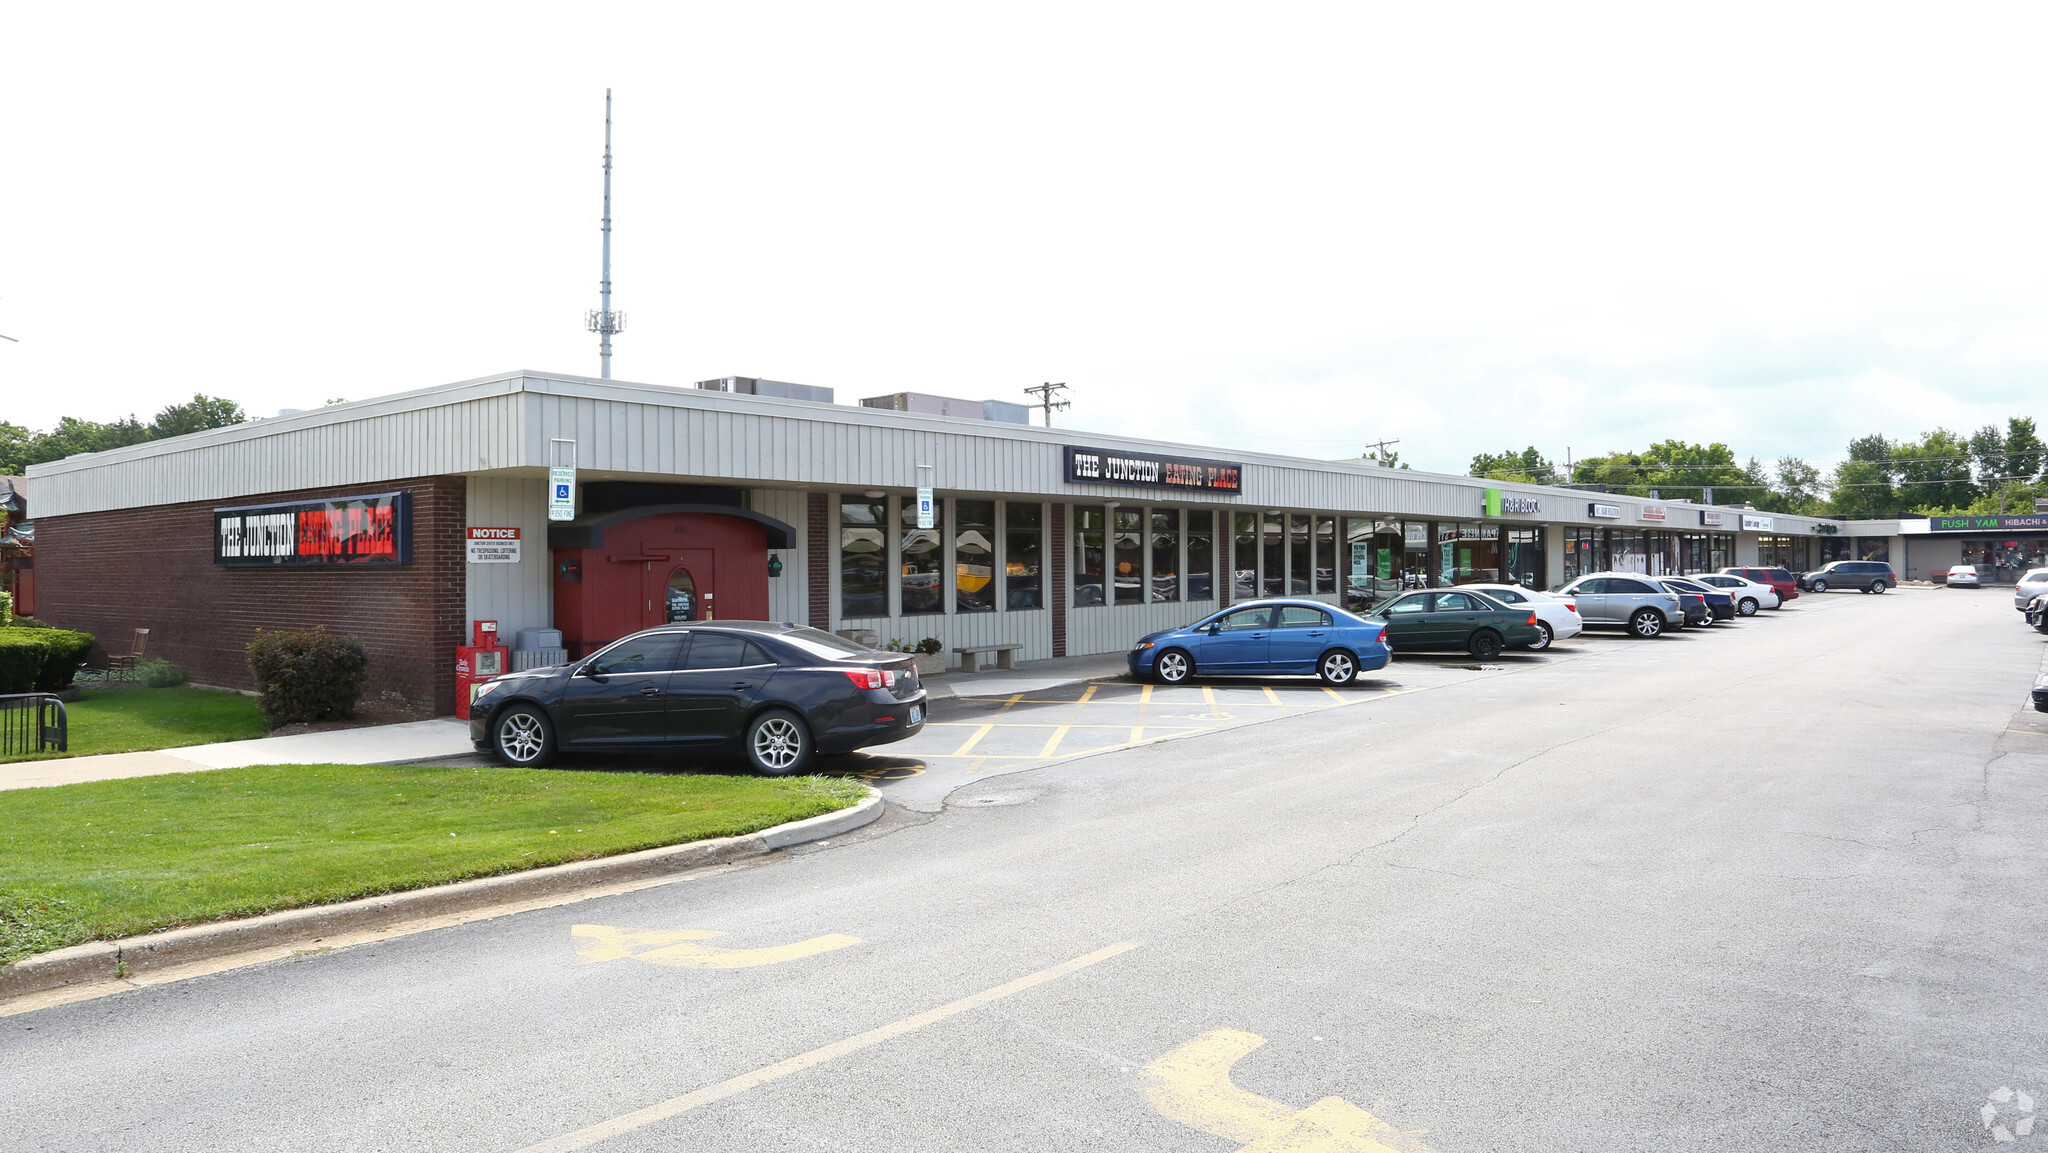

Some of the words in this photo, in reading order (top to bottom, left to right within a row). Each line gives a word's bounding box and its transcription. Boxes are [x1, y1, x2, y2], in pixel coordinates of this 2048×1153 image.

[1075, 454, 1099, 477] THE
[1105, 457, 1159, 482] JUNCTION
[1165, 463, 1203, 486] EATING
[1207, 467, 1238, 488] PLACE
[1503, 498, 1520, 512] H&R
[1521, 498, 1541, 513] BLOCK
[563, 510, 573, 518] FINE
[221, 517, 241, 557] THE
[243, 513, 295, 557] JUNCTION
[298, 509, 342, 555] EATING
[348, 506, 392, 554] PLACE
[472, 528, 516, 538] NOTICE
